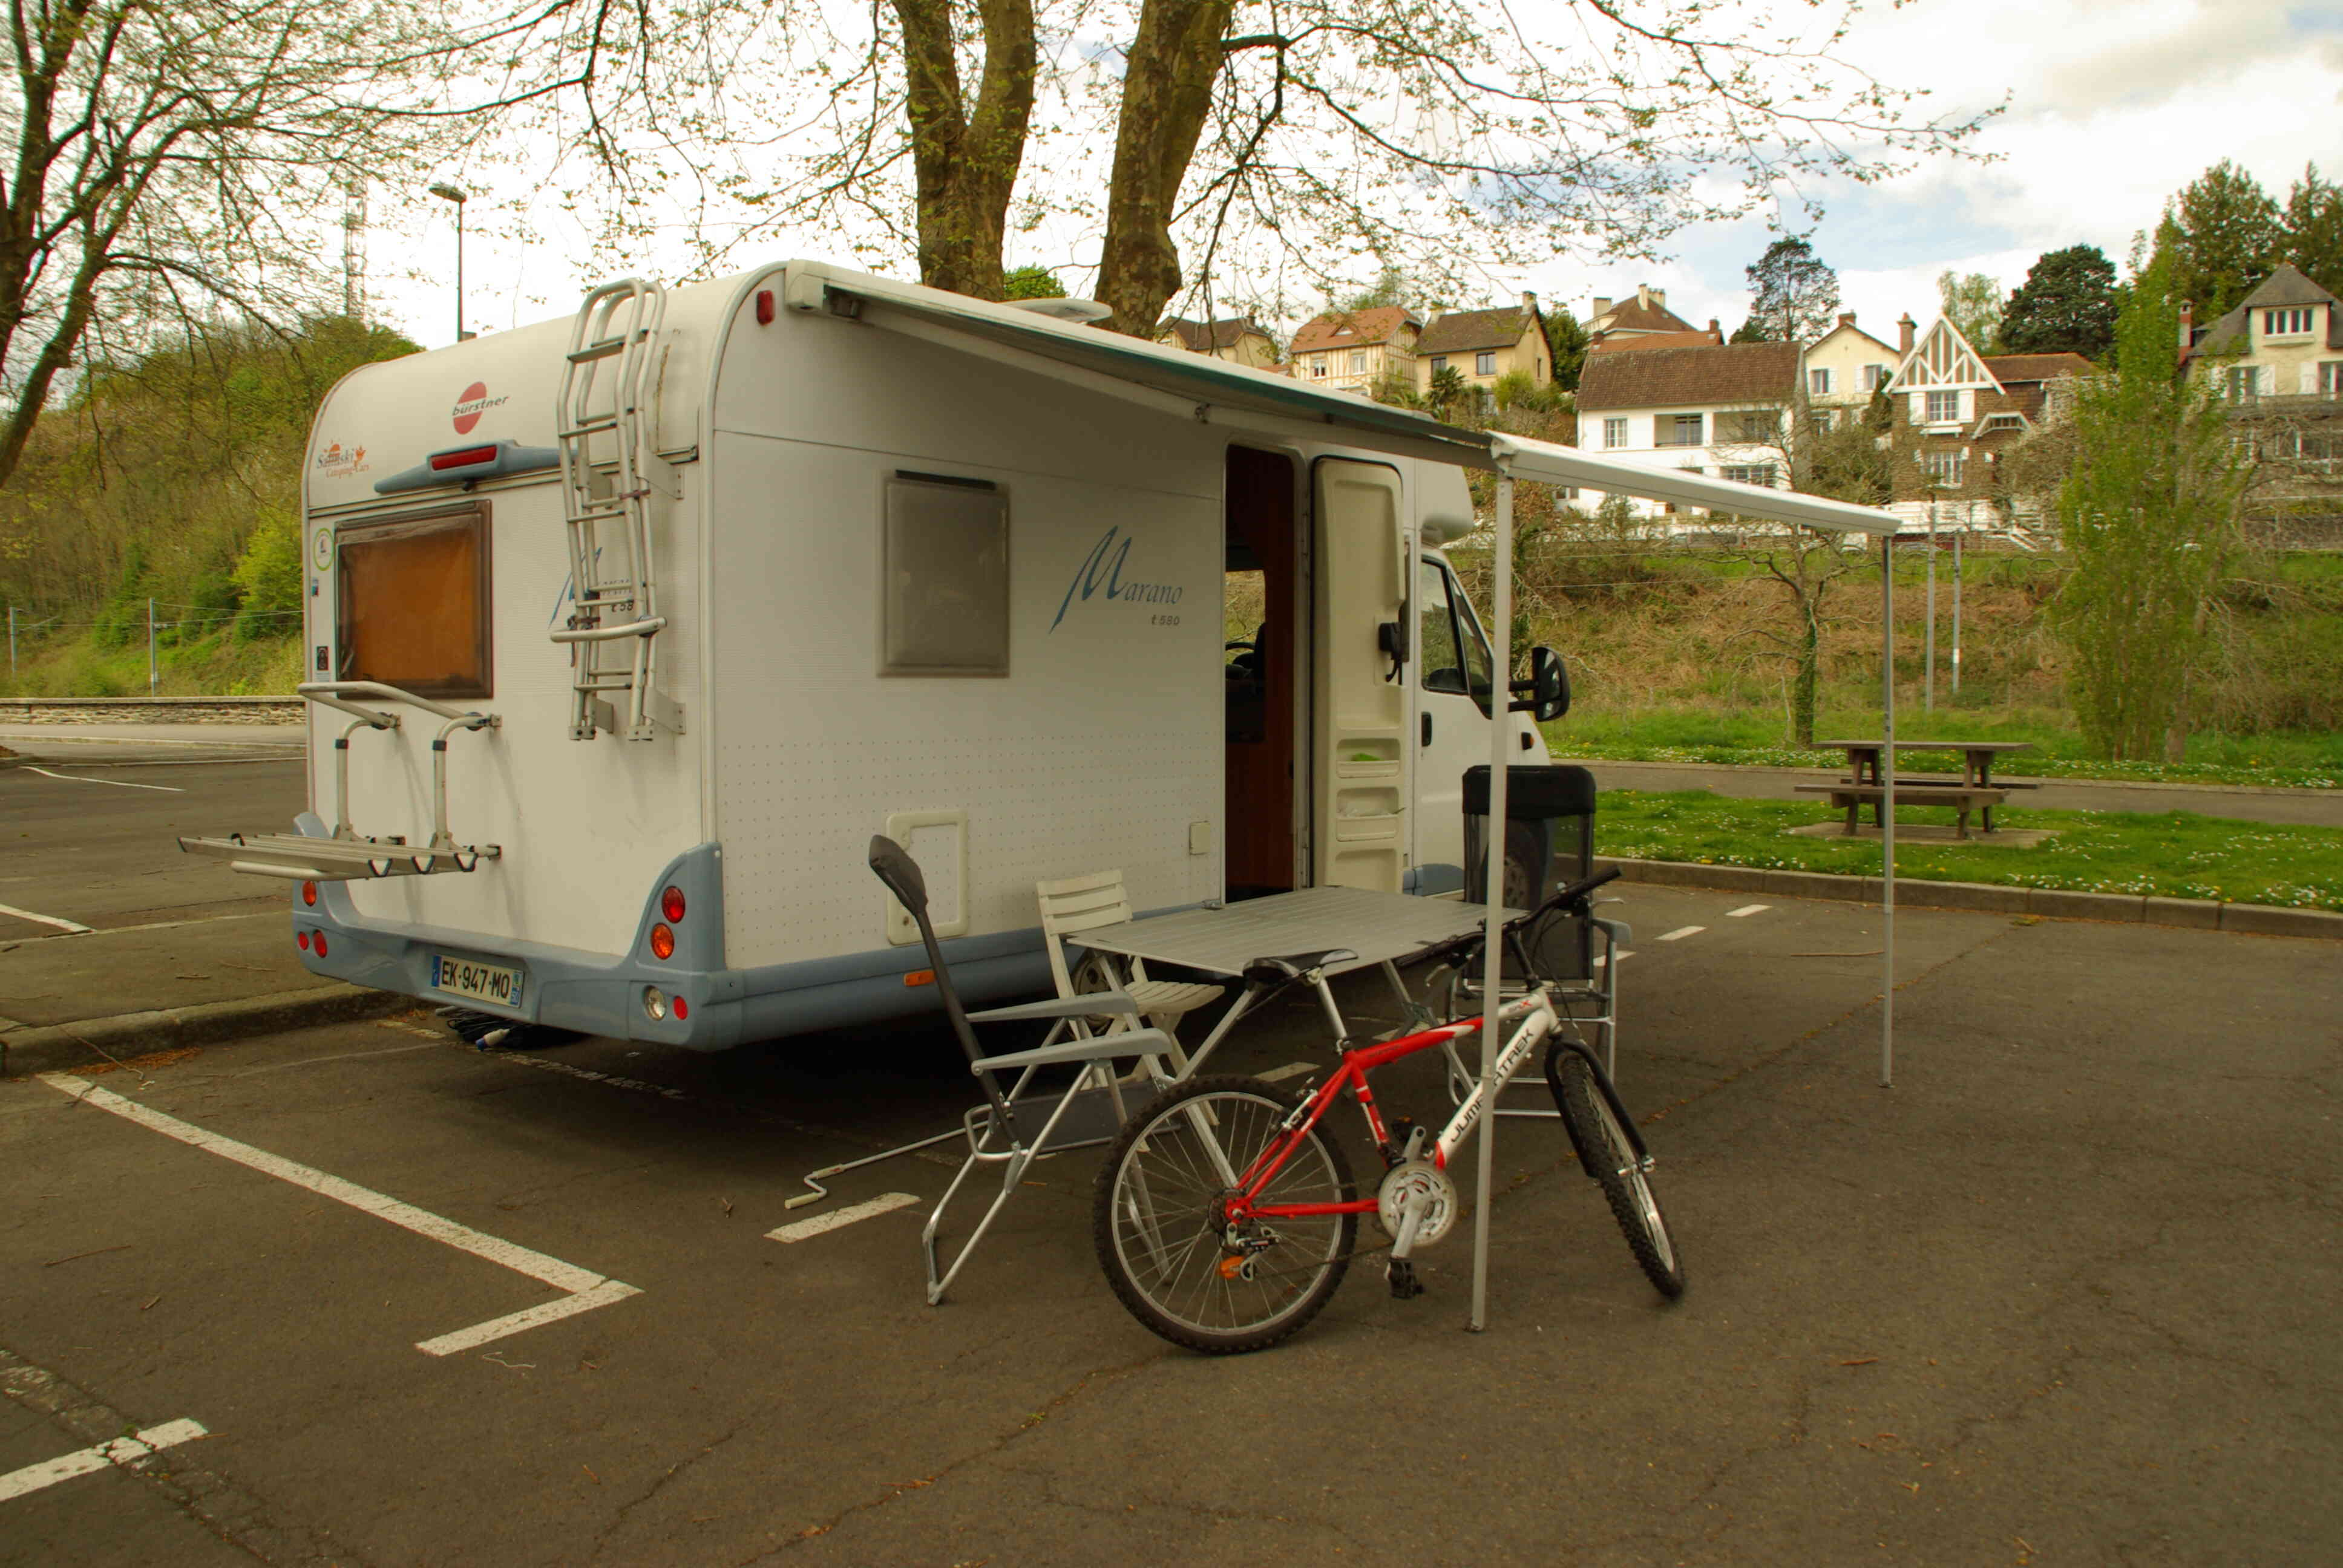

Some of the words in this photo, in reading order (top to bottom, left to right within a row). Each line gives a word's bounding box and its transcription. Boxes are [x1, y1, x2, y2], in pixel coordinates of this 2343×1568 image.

[451, 395, 511, 416] bürstner
[1049, 524, 1183, 634] Marano
[1159, 615, 1181, 626] 580
